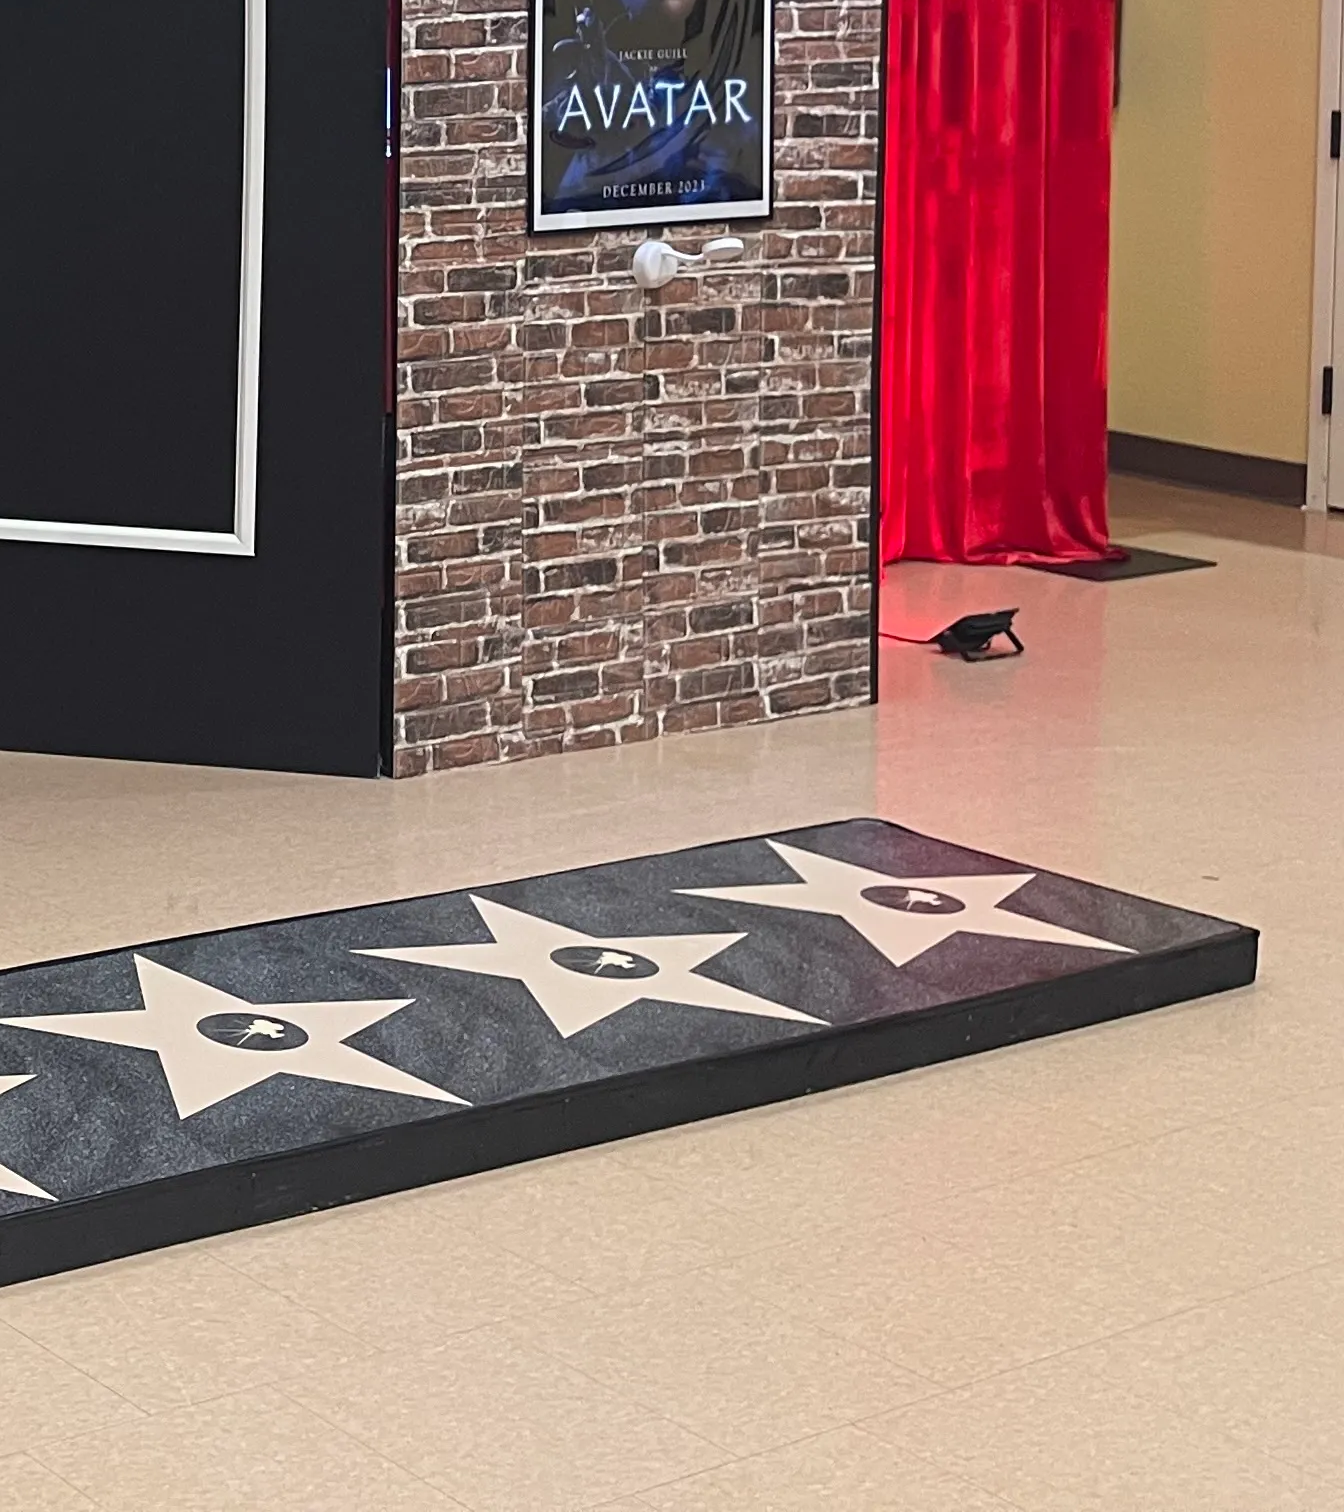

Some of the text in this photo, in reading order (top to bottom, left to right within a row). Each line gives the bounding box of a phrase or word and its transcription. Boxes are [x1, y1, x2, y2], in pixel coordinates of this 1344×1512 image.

[618, 48, 654, 62] JACKIE
[556, 78, 754, 133] AVATAR
[602, 178, 706, 199] DECEMBER 2023
